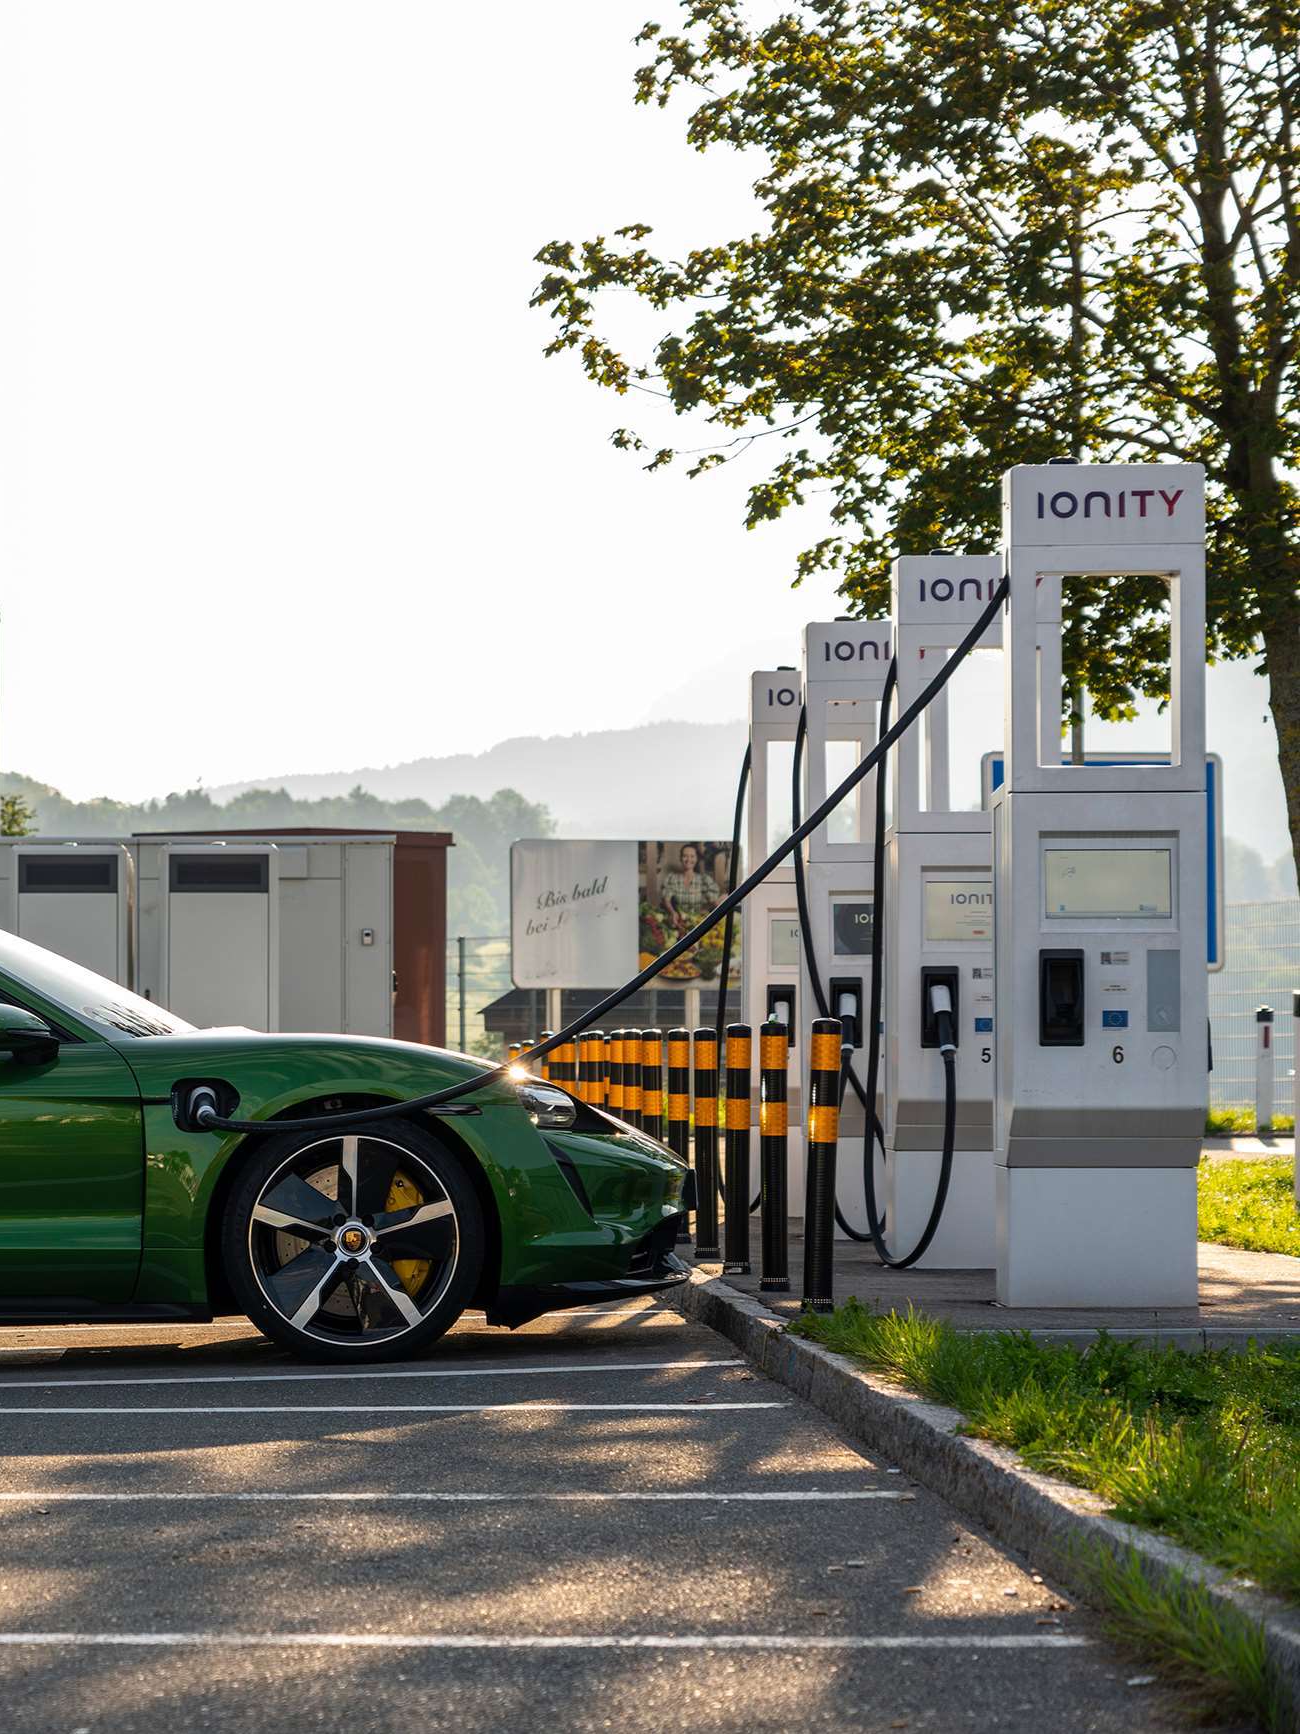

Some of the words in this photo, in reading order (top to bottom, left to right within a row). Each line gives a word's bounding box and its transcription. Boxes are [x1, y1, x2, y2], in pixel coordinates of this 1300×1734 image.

[1037, 490, 1184, 519] IONITY
[919, 578, 1005, 602] IONI
[537, 890, 568, 909] Bis
[572, 876, 608, 901] bald
[526, 917, 548, 936] bei
[981, 1048, 992, 1063] 5
[1112, 1045, 1124, 1064] 6
